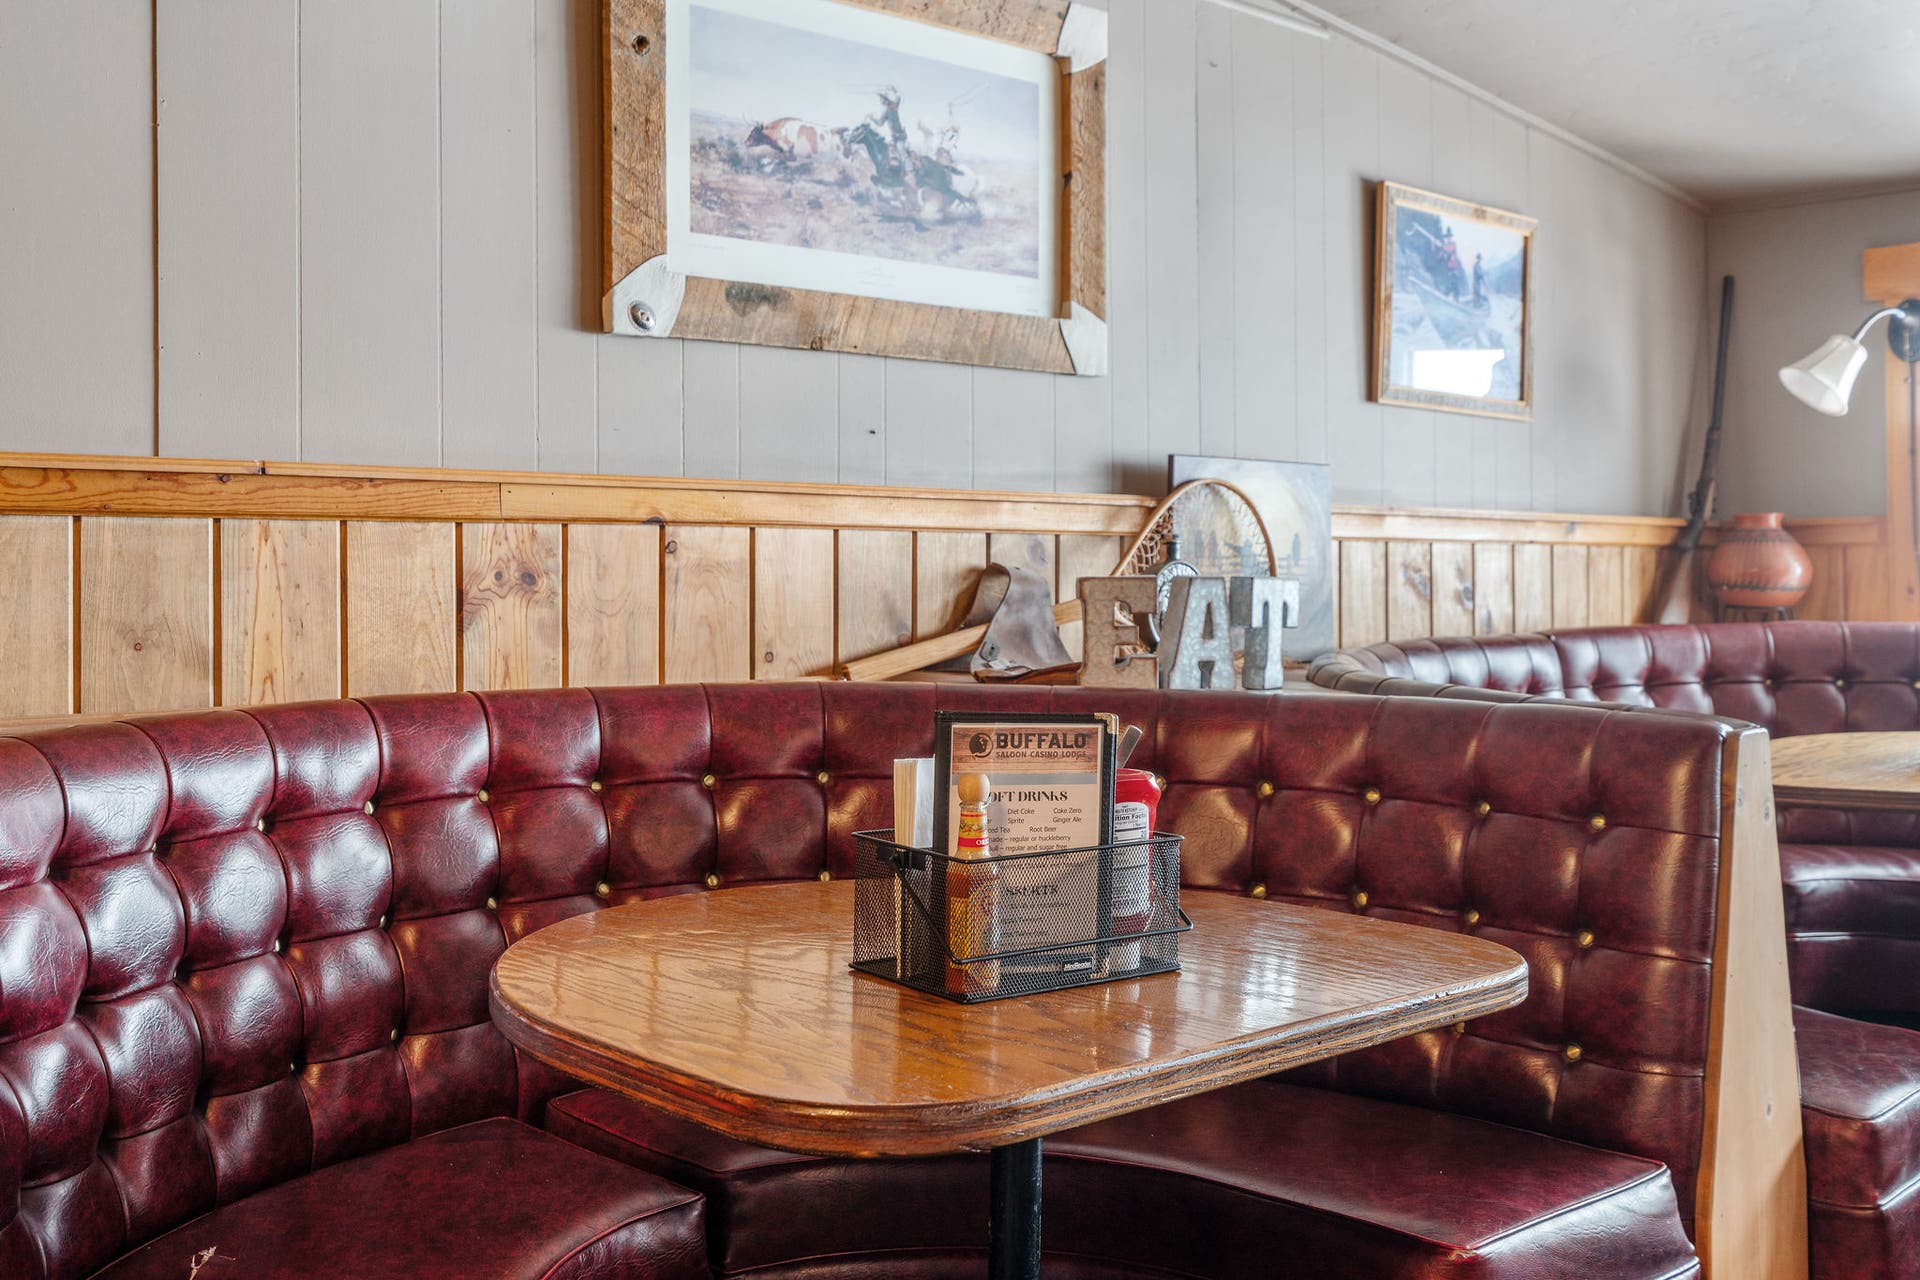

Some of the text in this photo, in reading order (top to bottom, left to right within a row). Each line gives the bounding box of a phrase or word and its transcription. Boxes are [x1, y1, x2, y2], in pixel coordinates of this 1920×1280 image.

[1077, 576, 1300, 690] EAT
[996, 732, 1087, 749] BUFFALO
[996, 750, 1087, 759] SALOON CASINO LODGE
[988, 790, 1069, 803] OFT DRINKS
[1052, 817, 1071, 825] Ginger
[1009, 836, 1030, 844] regular
[1038, 834, 1072, 843] huckleberry
[1038, 845, 1055, 853] sugar
